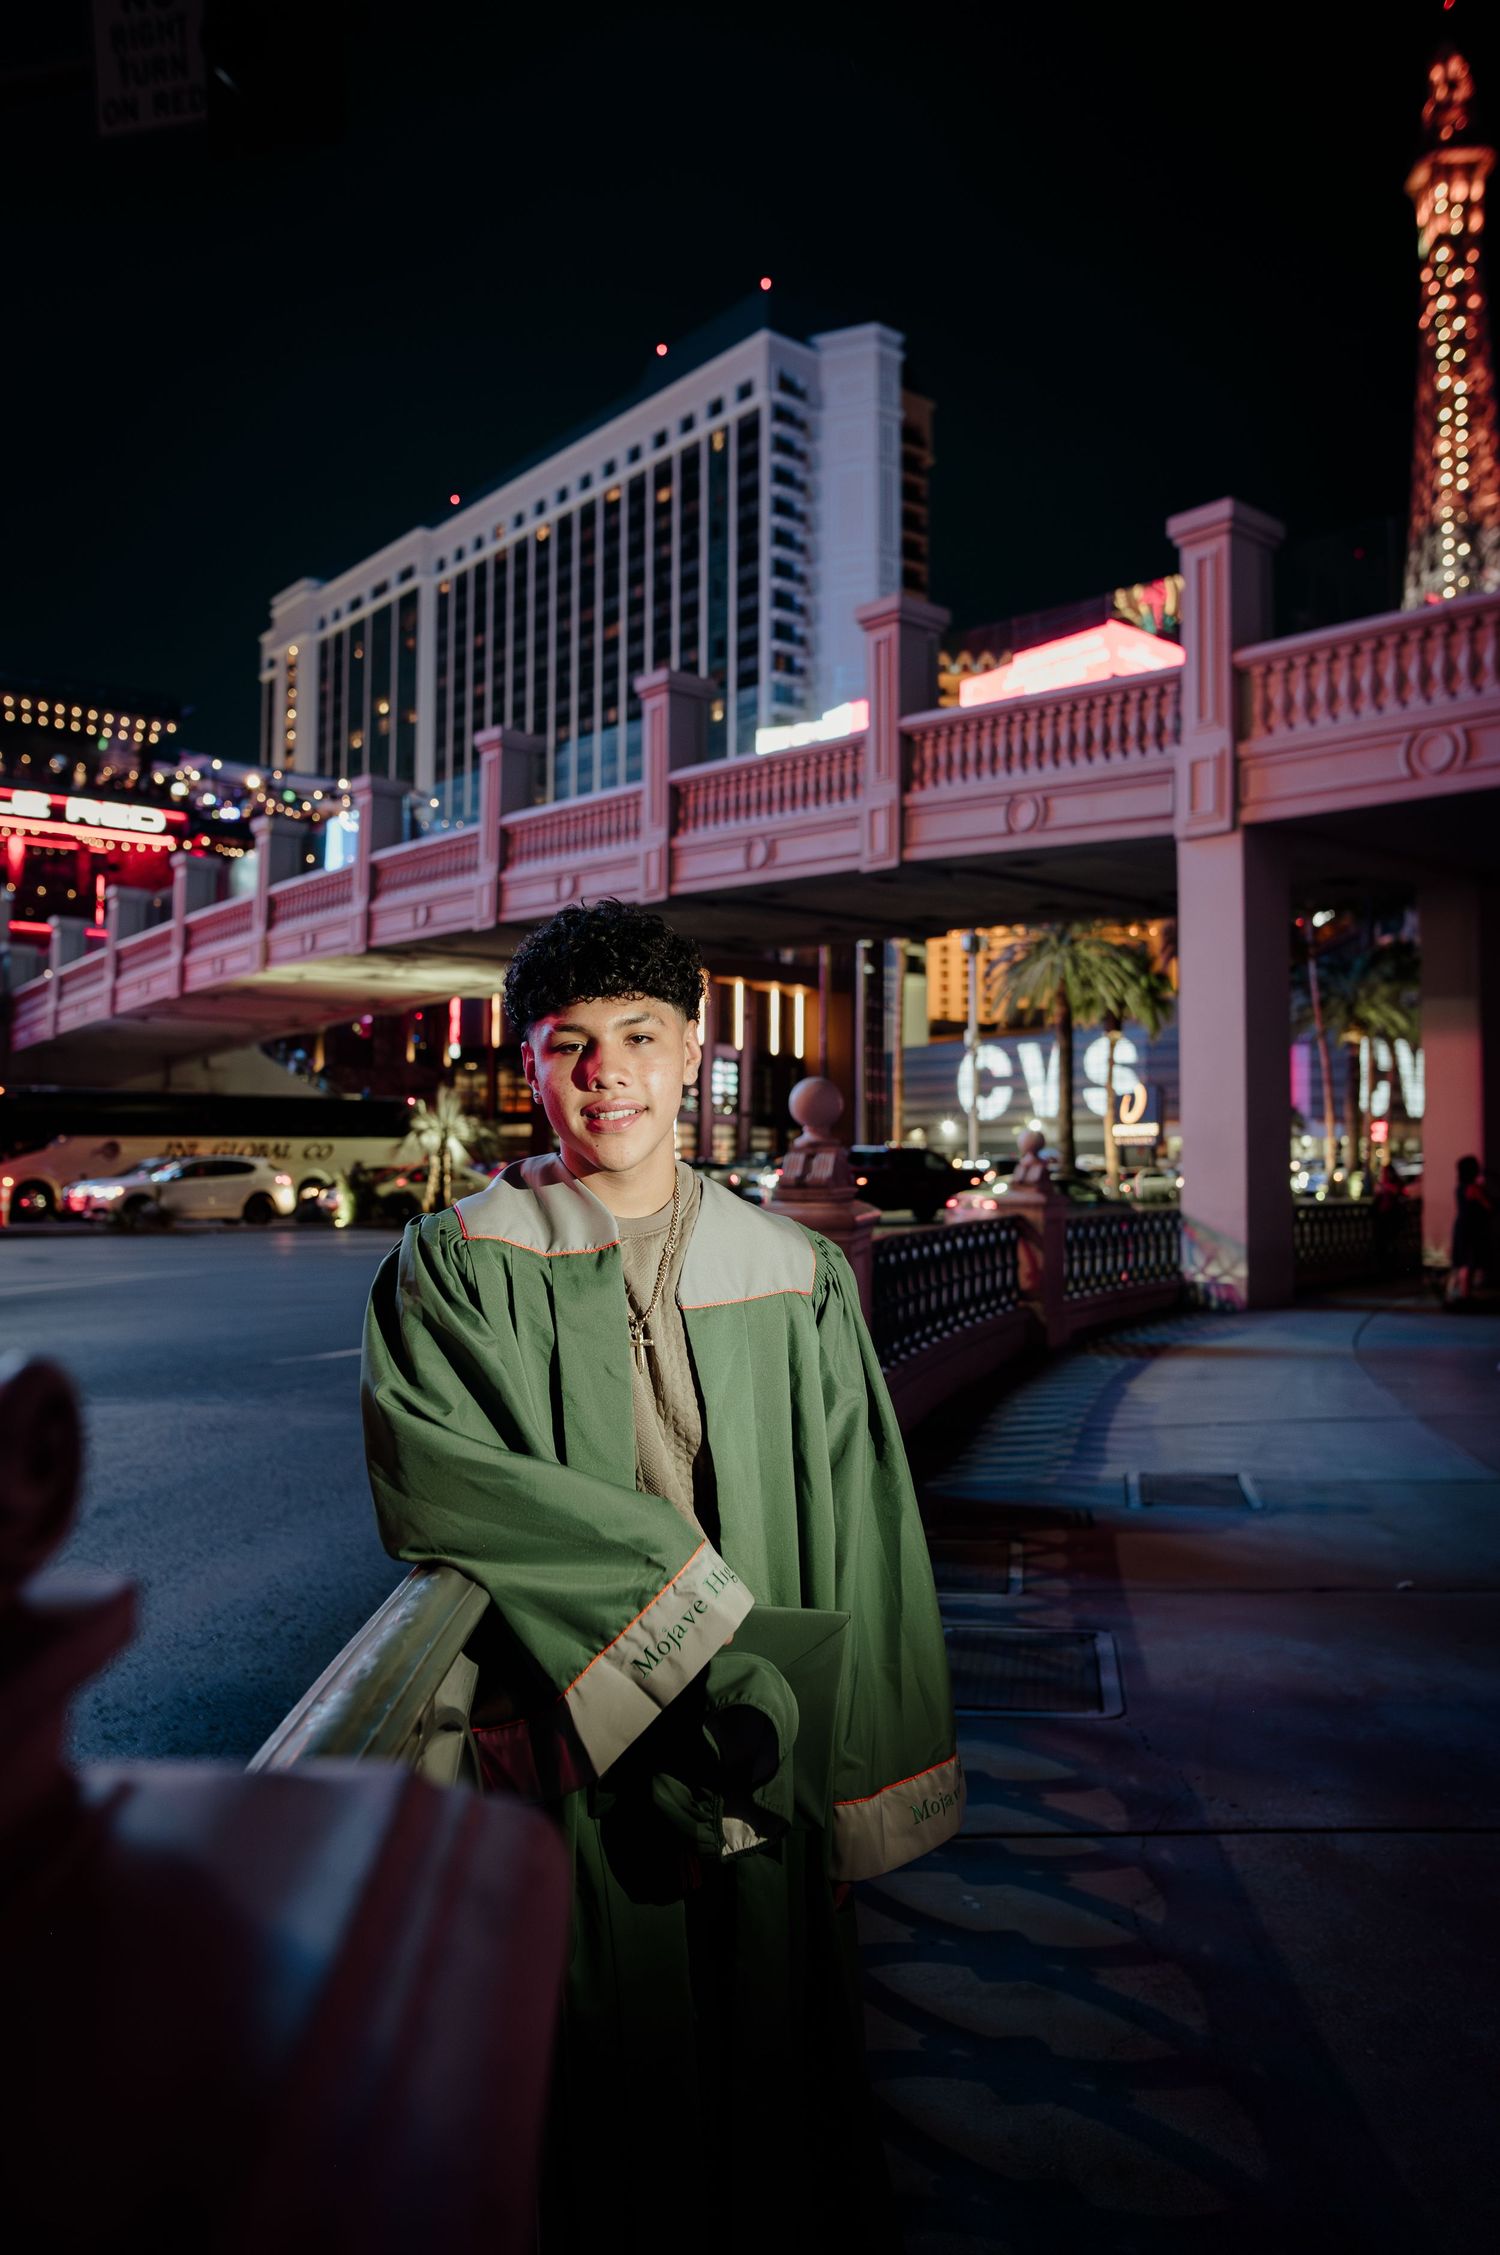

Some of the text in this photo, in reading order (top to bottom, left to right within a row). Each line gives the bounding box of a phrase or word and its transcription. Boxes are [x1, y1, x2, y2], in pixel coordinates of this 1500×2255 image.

[109, 12, 188, 53] RIGHT
[118, 51, 190, 89] TURN
[102, 83, 206, 127] ON RED
[65, 796, 167, 833] RED
[957, 1036, 1138, 1122] CVS
[211, 1142, 291, 1158] GLOBAL
[303, 1142, 335, 1160] CO
[630, 1599, 709, 1679] Mojave
